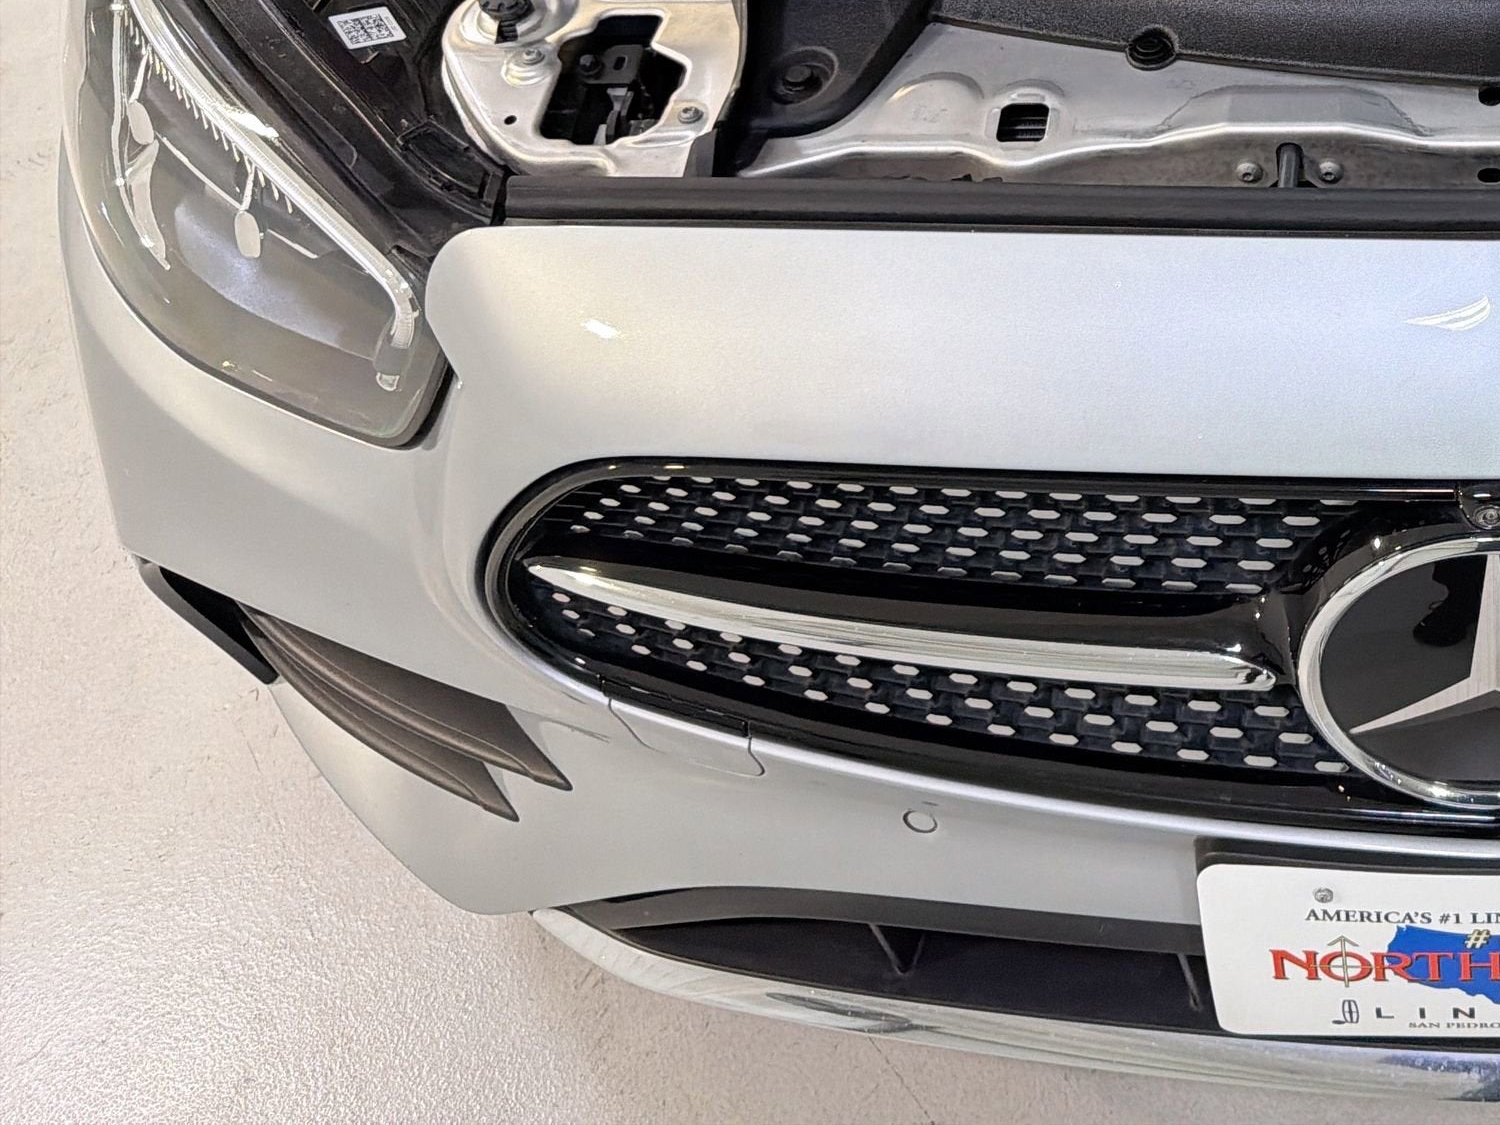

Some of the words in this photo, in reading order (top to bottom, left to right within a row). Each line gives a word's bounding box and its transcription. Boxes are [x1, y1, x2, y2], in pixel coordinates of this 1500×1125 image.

[1304, 908, 1433, 925] AMERICA'S
[1438, 911, 1463, 925] #1
[1408, 1021, 1441, 1029] SAN
